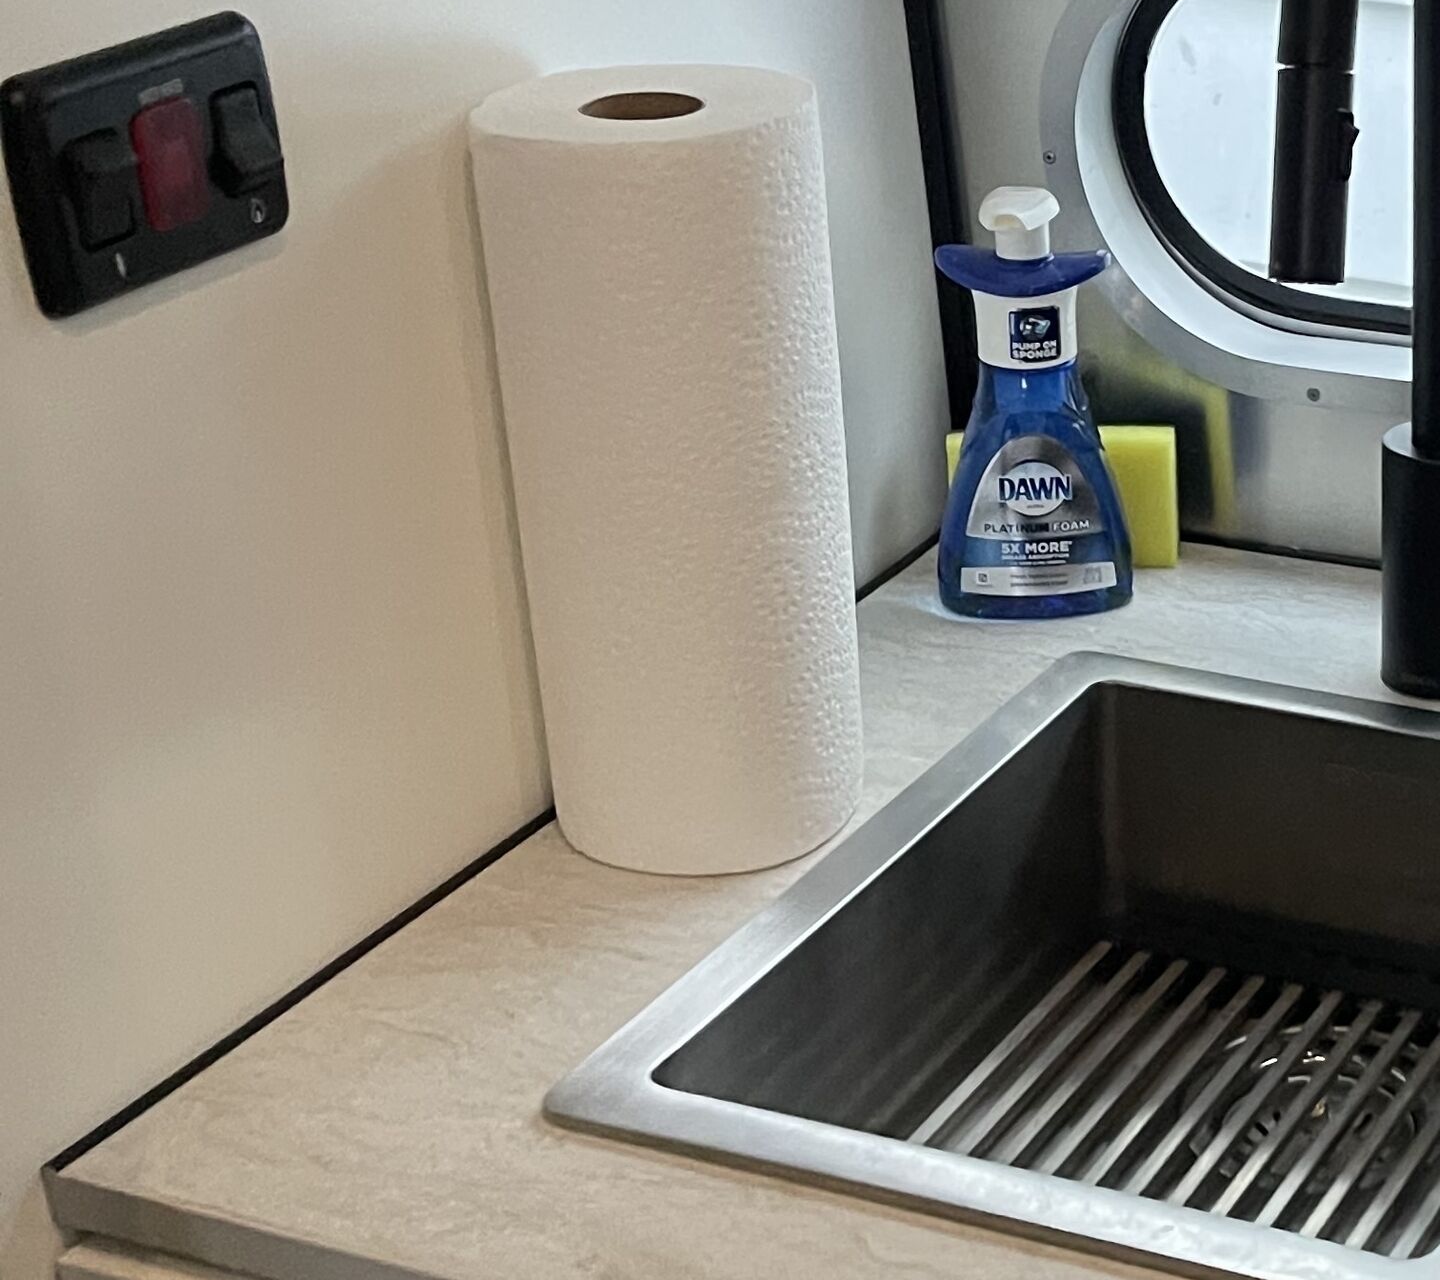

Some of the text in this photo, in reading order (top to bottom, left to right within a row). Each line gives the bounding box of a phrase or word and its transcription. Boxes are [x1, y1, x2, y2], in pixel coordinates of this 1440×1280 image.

[1012, 340, 1057, 350] PUMP ON
[1012, 348, 1057, 359] SPONGE
[998, 475, 1072, 501] DAWN
[984, 520, 1090, 534] PLATINUM FOAM
[1001, 542, 1021, 555] 5X
